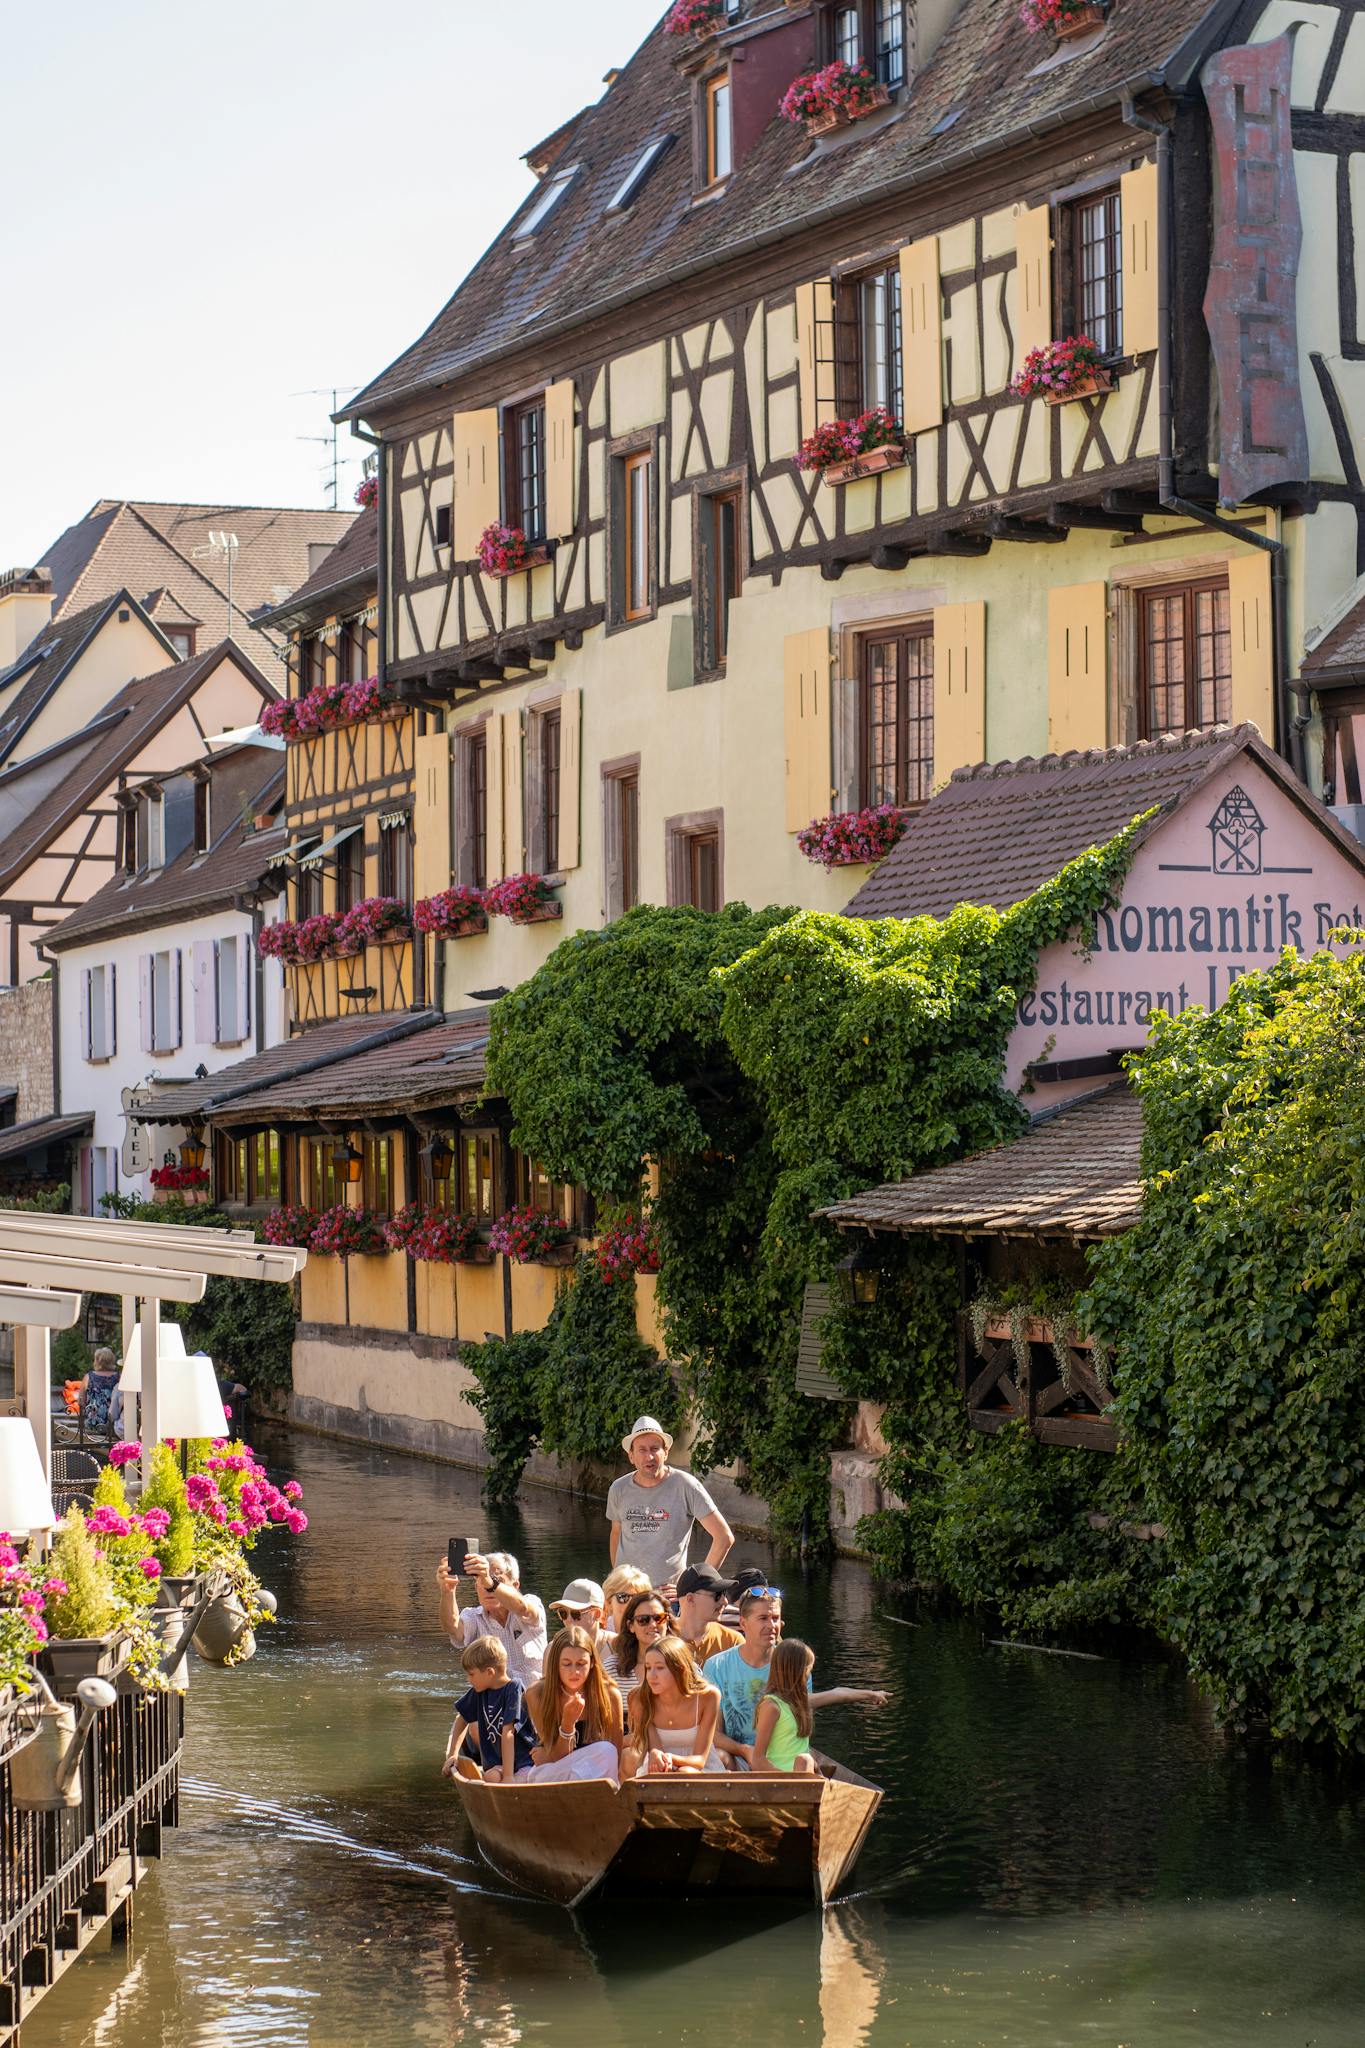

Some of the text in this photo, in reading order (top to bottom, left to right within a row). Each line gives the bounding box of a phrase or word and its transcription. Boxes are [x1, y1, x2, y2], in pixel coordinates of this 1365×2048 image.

[1234, 83, 1288, 458] HOTEL
[1086, 891, 1304, 953] Romantik
[1016, 980, 1190, 1026] estaurant
